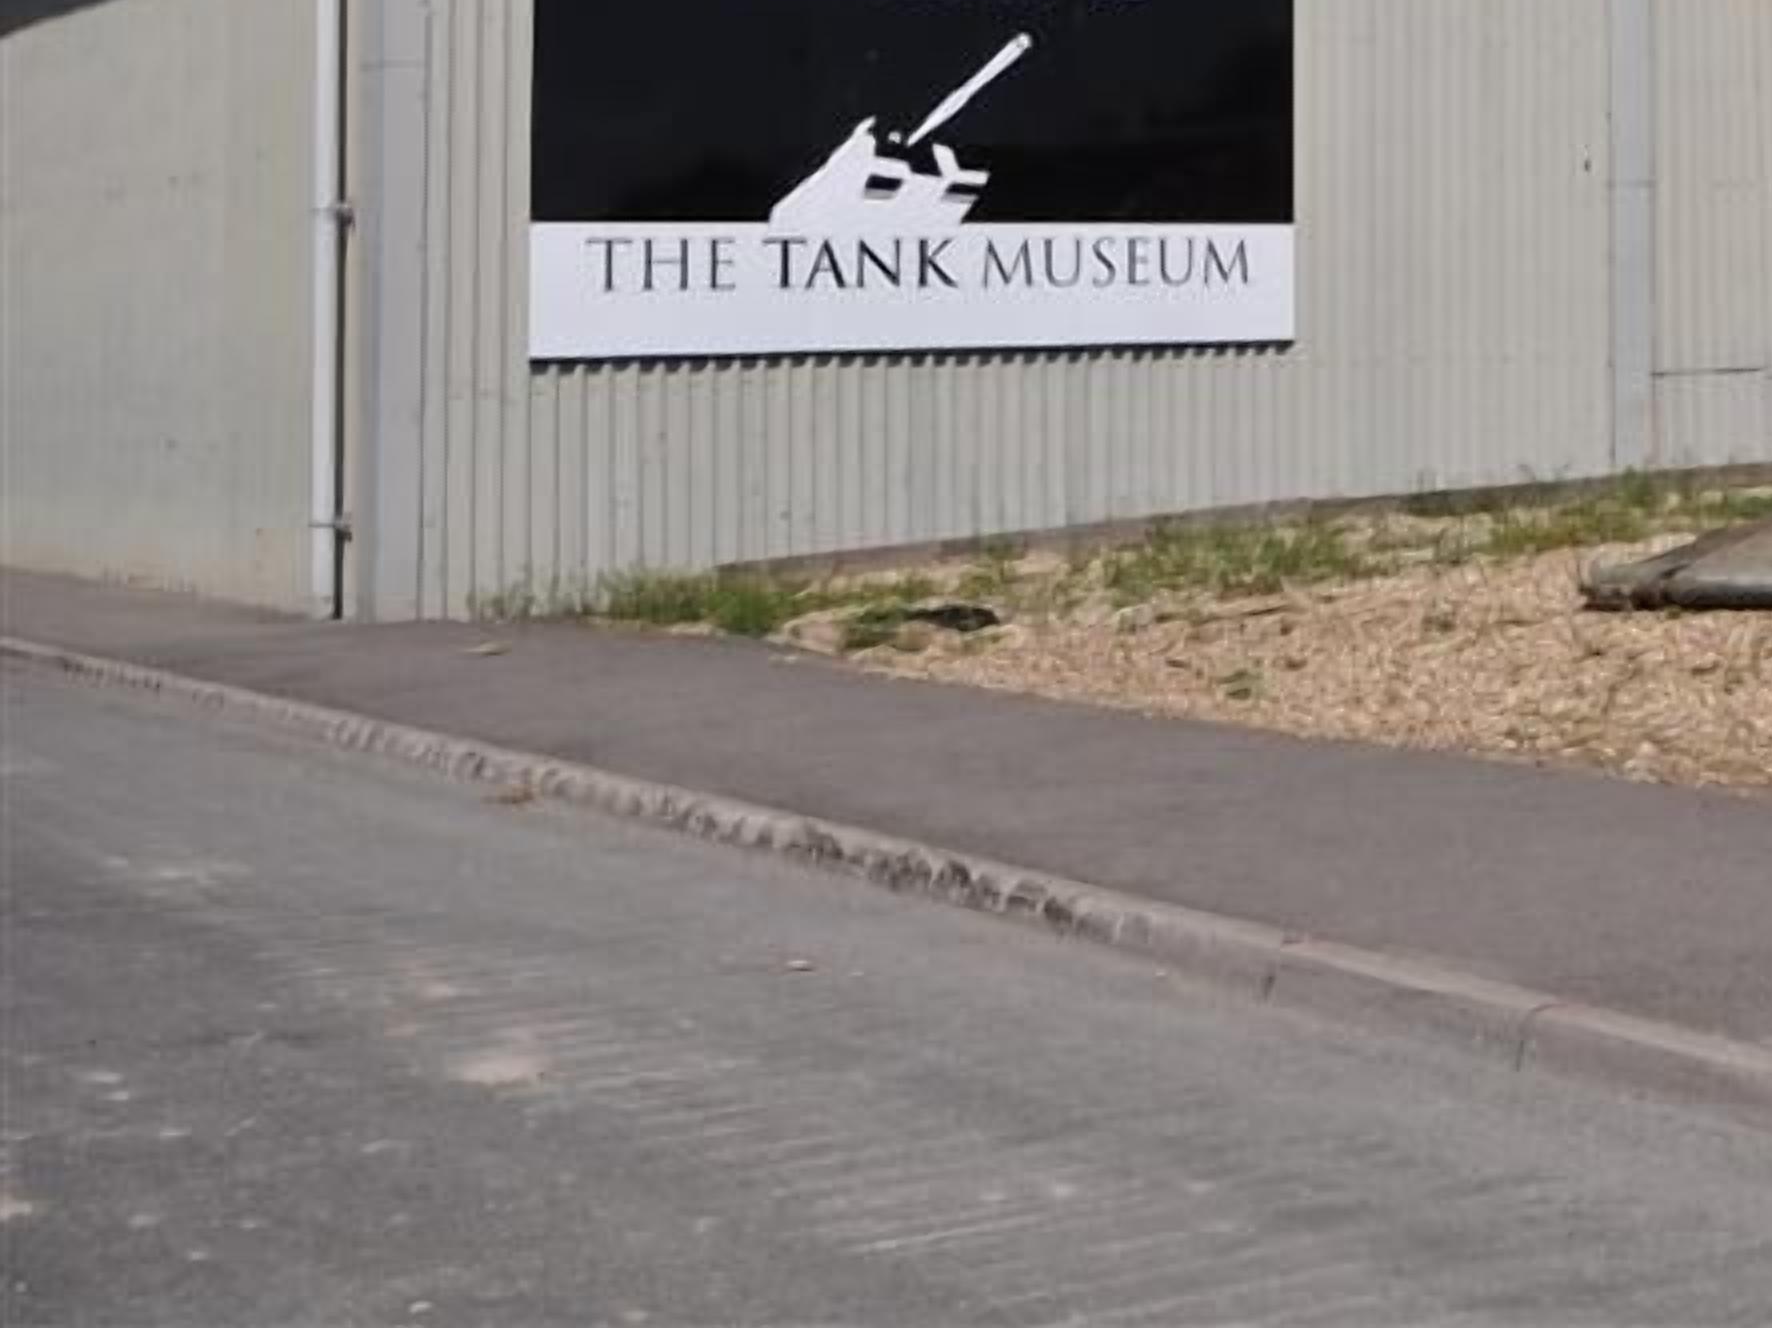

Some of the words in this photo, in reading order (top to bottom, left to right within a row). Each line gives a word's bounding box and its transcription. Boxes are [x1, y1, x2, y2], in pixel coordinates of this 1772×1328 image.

[585, 237, 736, 292] THE
[761, 237, 959, 290] TANK
[983, 237, 1249, 288] MUSEUM
